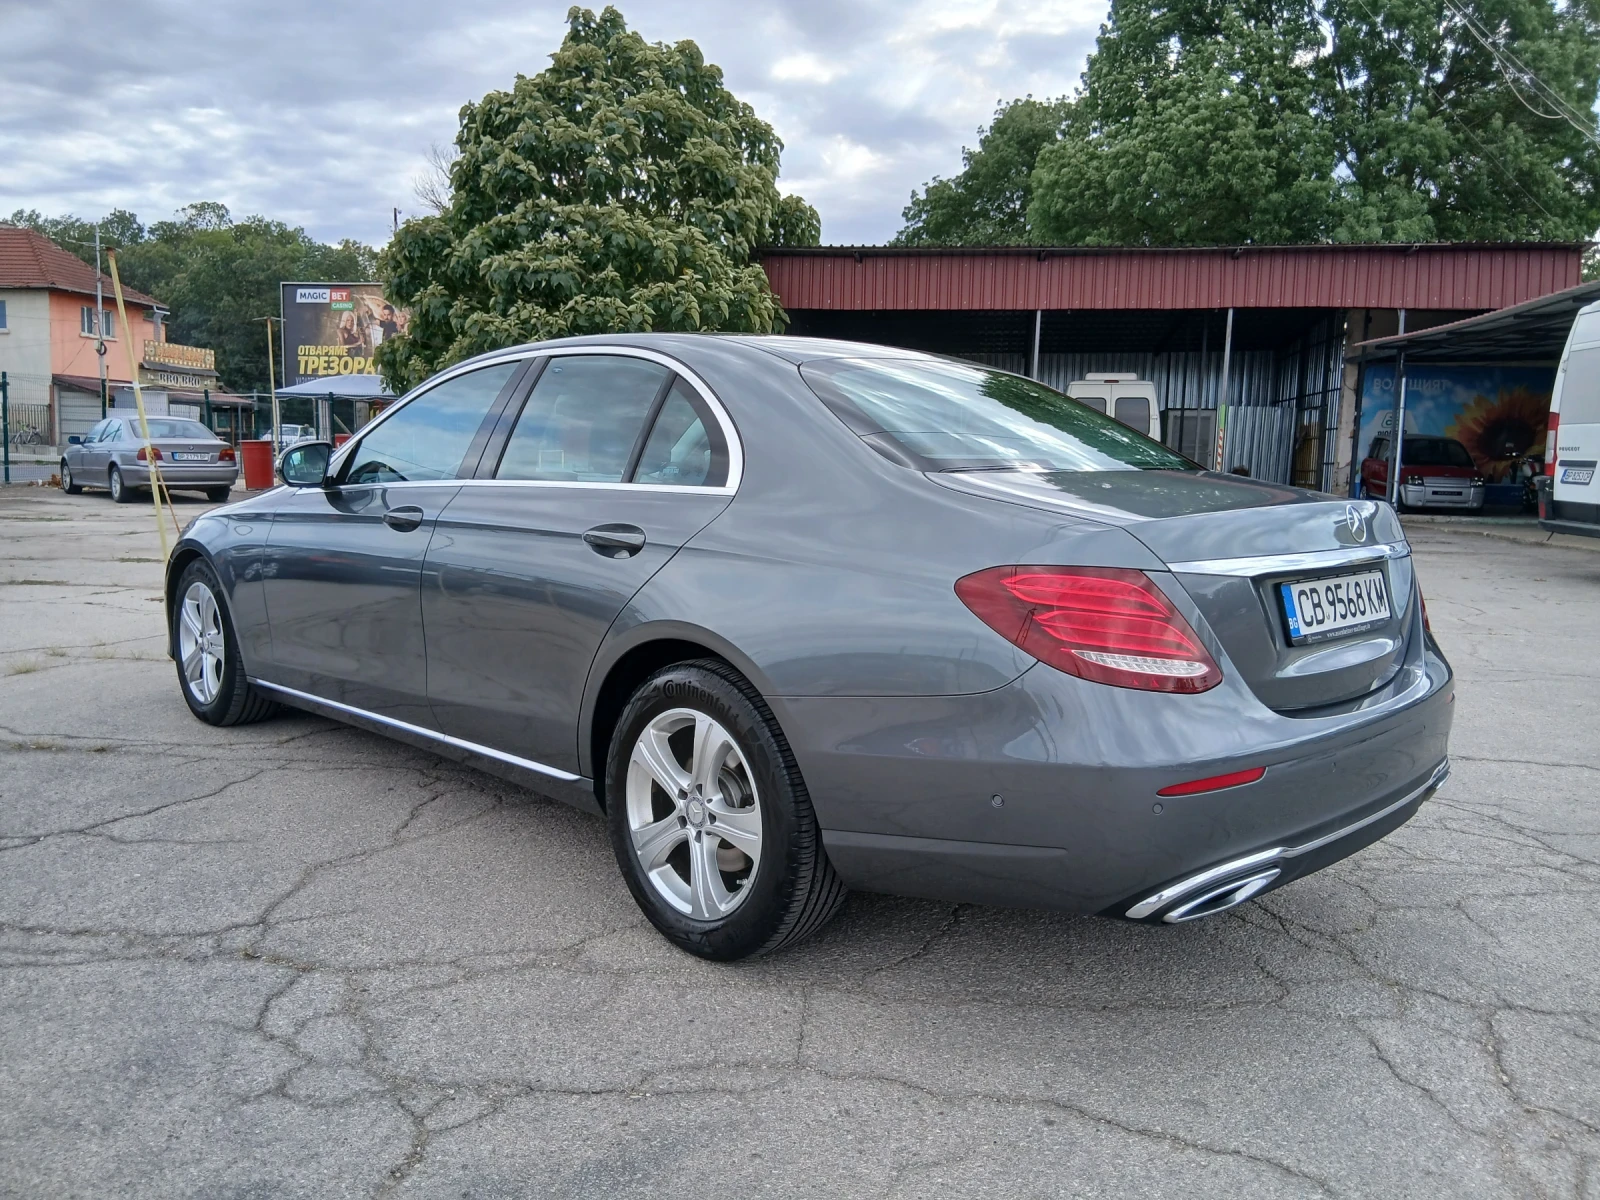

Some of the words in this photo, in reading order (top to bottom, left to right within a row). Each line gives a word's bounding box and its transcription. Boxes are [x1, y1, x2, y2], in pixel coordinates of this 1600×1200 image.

[300, 292, 327, 300] MAGIC
[331, 292, 347, 300] BET
[298, 345, 349, 356] ОТВАРЯМЕ
[298, 356, 376, 375] ТРЕЗОРА
[1373, 378, 1447, 391] ВОЩИЯТ
[1298, 587, 1325, 627] CB
[1325, 581, 1367, 622] 9568
[1364, 578, 1387, 615] KM
[1288, 617, 1299, 630] BG
[663, 679, 732, 717] Continental
